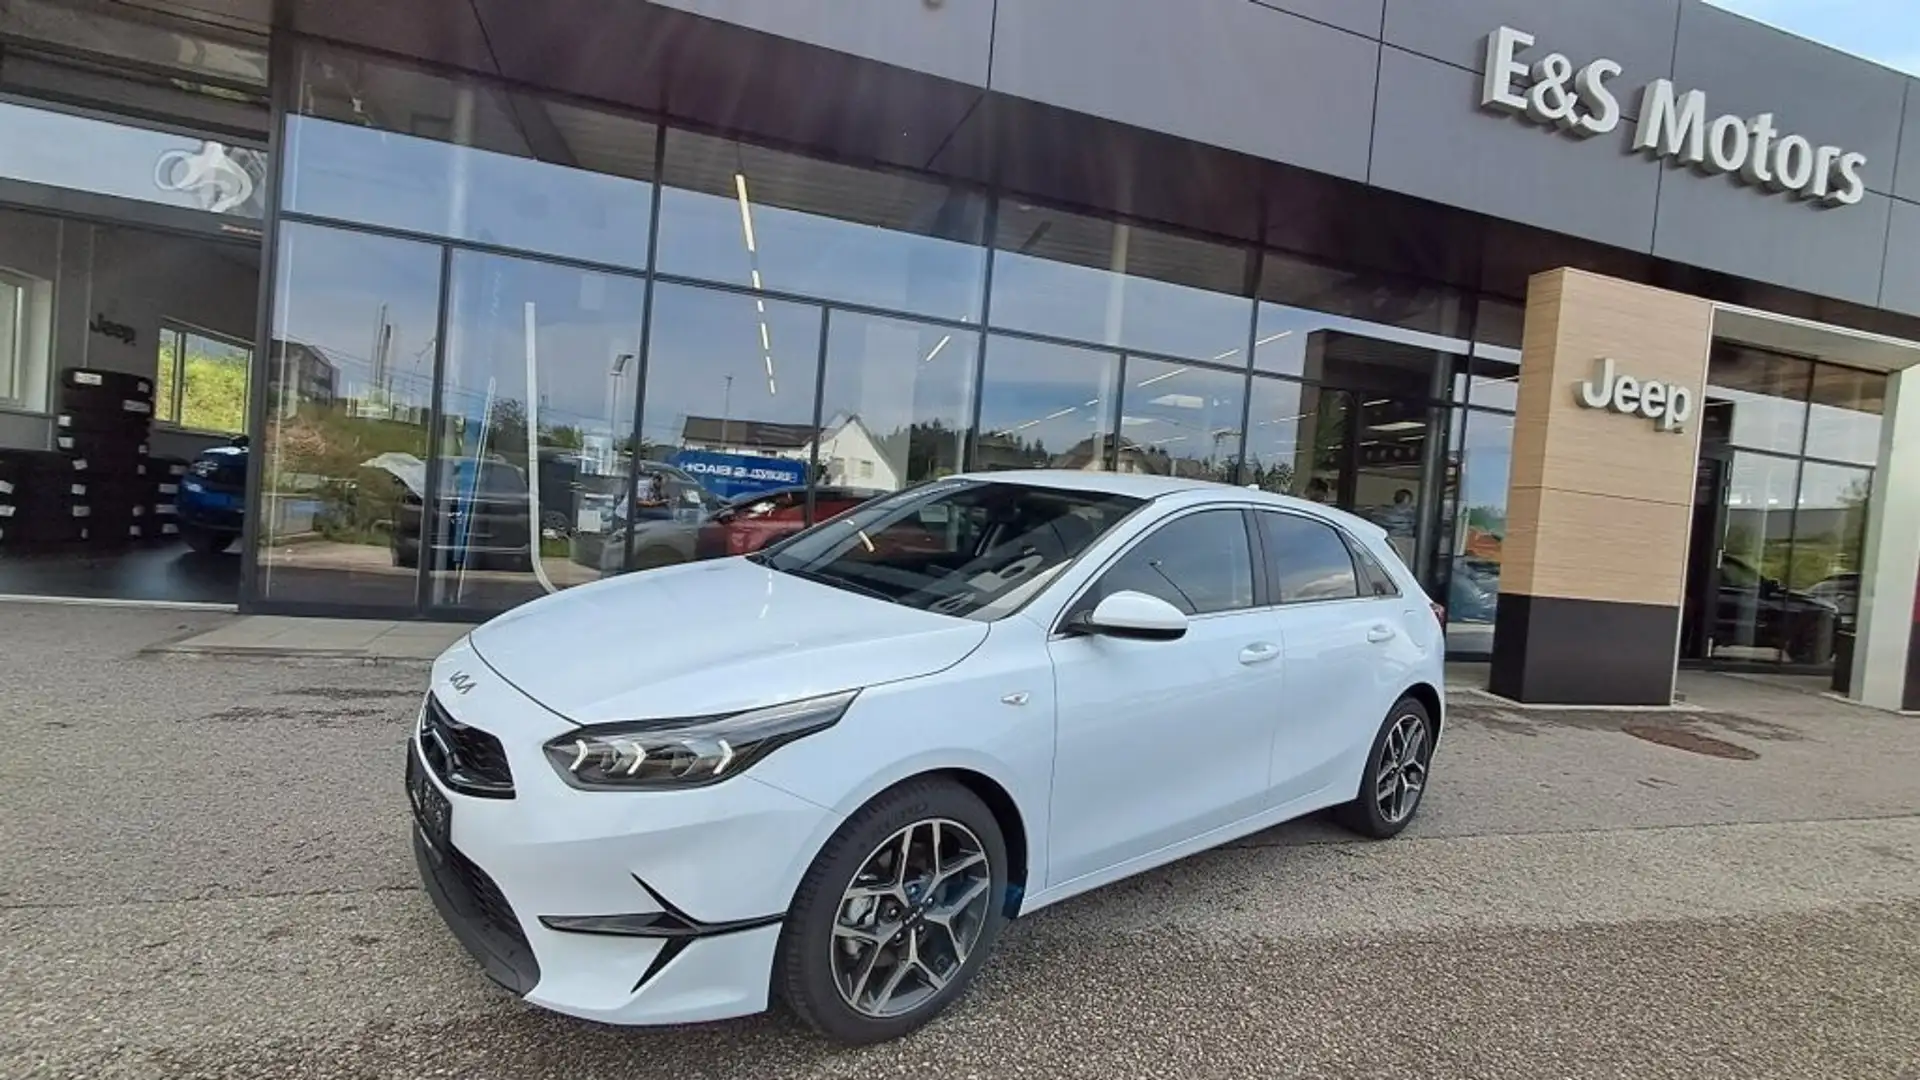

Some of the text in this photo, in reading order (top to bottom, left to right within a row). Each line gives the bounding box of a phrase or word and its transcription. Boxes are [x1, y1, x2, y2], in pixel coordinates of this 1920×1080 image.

[1482, 26, 1866, 205] E&S Motors
[1579, 357, 1691, 431] Jeep
